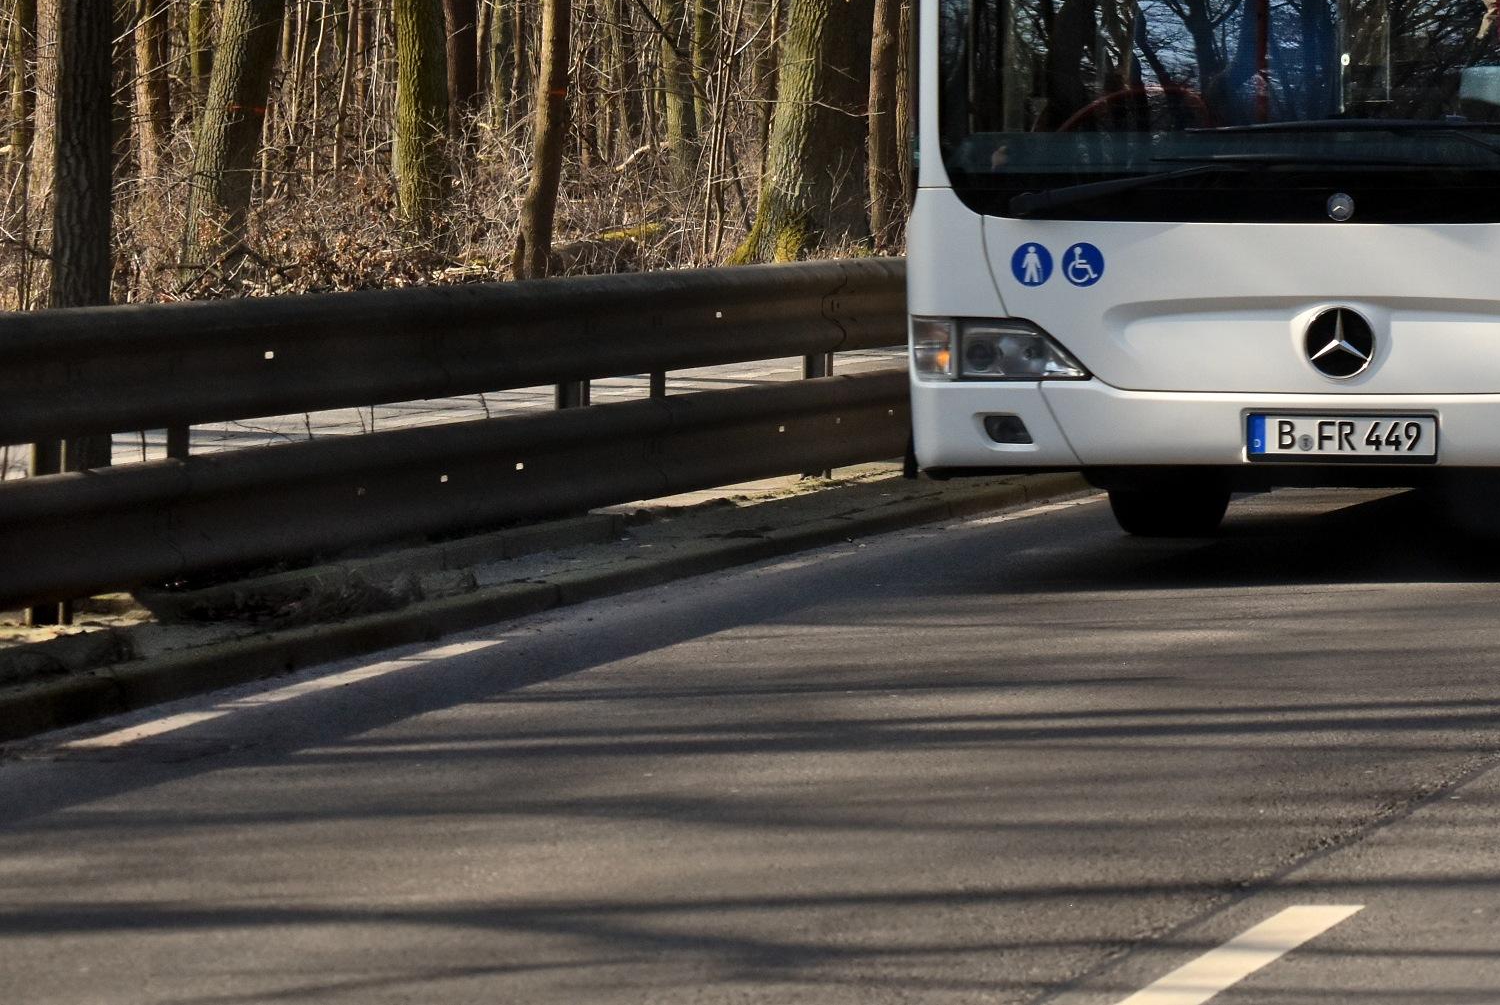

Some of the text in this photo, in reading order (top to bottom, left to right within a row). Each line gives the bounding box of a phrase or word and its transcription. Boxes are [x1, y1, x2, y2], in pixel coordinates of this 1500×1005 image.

[1253, 438, 1261, 448] D
[1278, 420, 1421, 451] B FR 449
